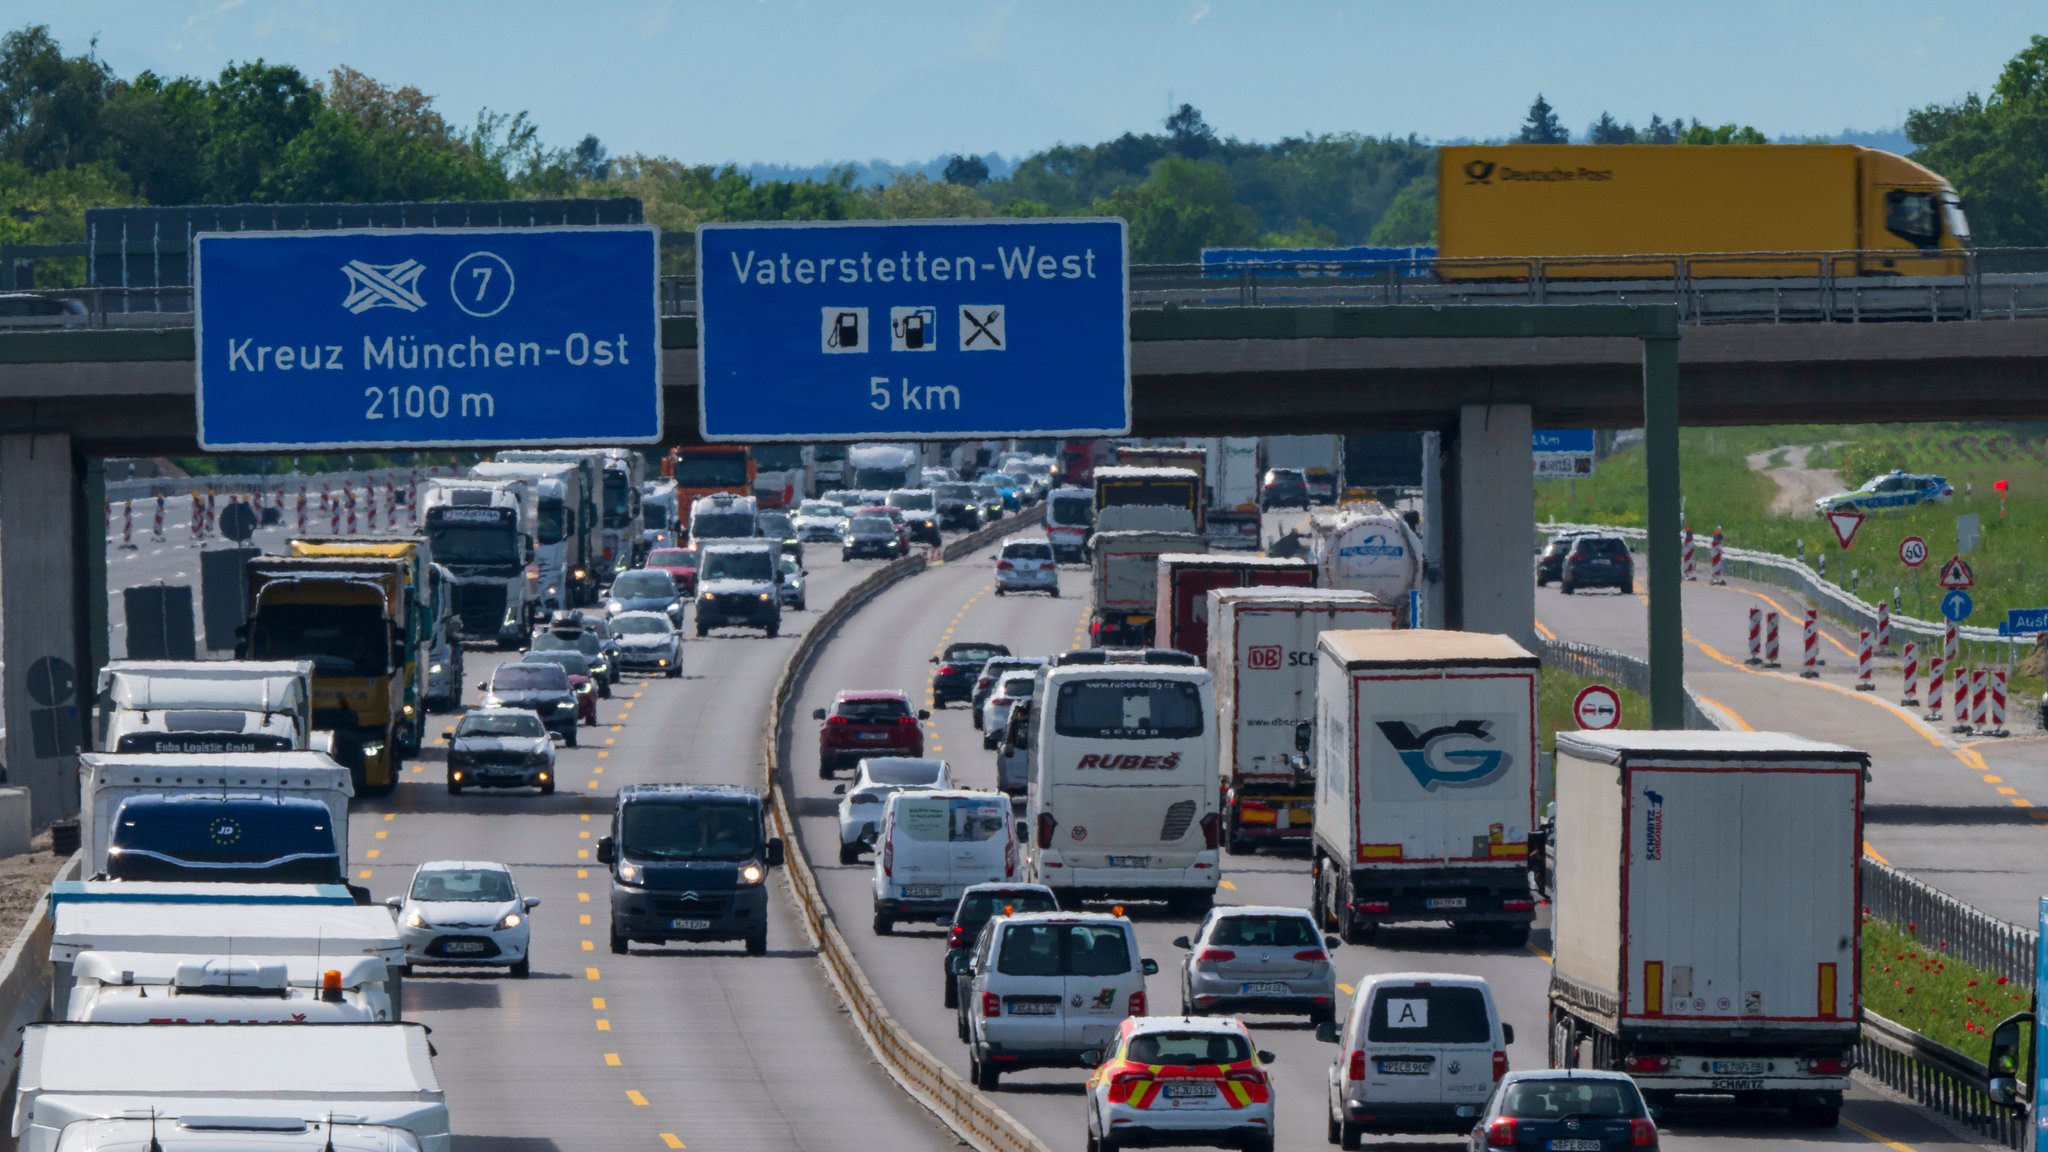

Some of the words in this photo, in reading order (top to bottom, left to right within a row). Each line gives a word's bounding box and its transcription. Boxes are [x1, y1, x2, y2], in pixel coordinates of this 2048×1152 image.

[1501, 167, 1574, 181] Deutsche
[1578, 167, 1613, 181] Post
[731, 246, 1096, 284] Vaterstetten-West
[472, 267, 493, 302] 7
[228, 338, 344, 373] Kreuz
[363, 332, 630, 371] München-Ost
[364, 385, 450, 420] 2100
[461, 393, 495, 418] m
[870, 376, 892, 411] 5
[902, 377, 961, 411] km
[1905, 544, 1924, 560] 60
[1252, 649, 1278, 667] DB
[1076, 752, 1184, 770] RUBEŠ
[217, 826, 234, 835] JD
[1646, 809, 1655, 861] SCHMITZ
[1398, 1003, 1416, 1023] A
[1711, 1079, 1765, 1089] SCHMITZ
